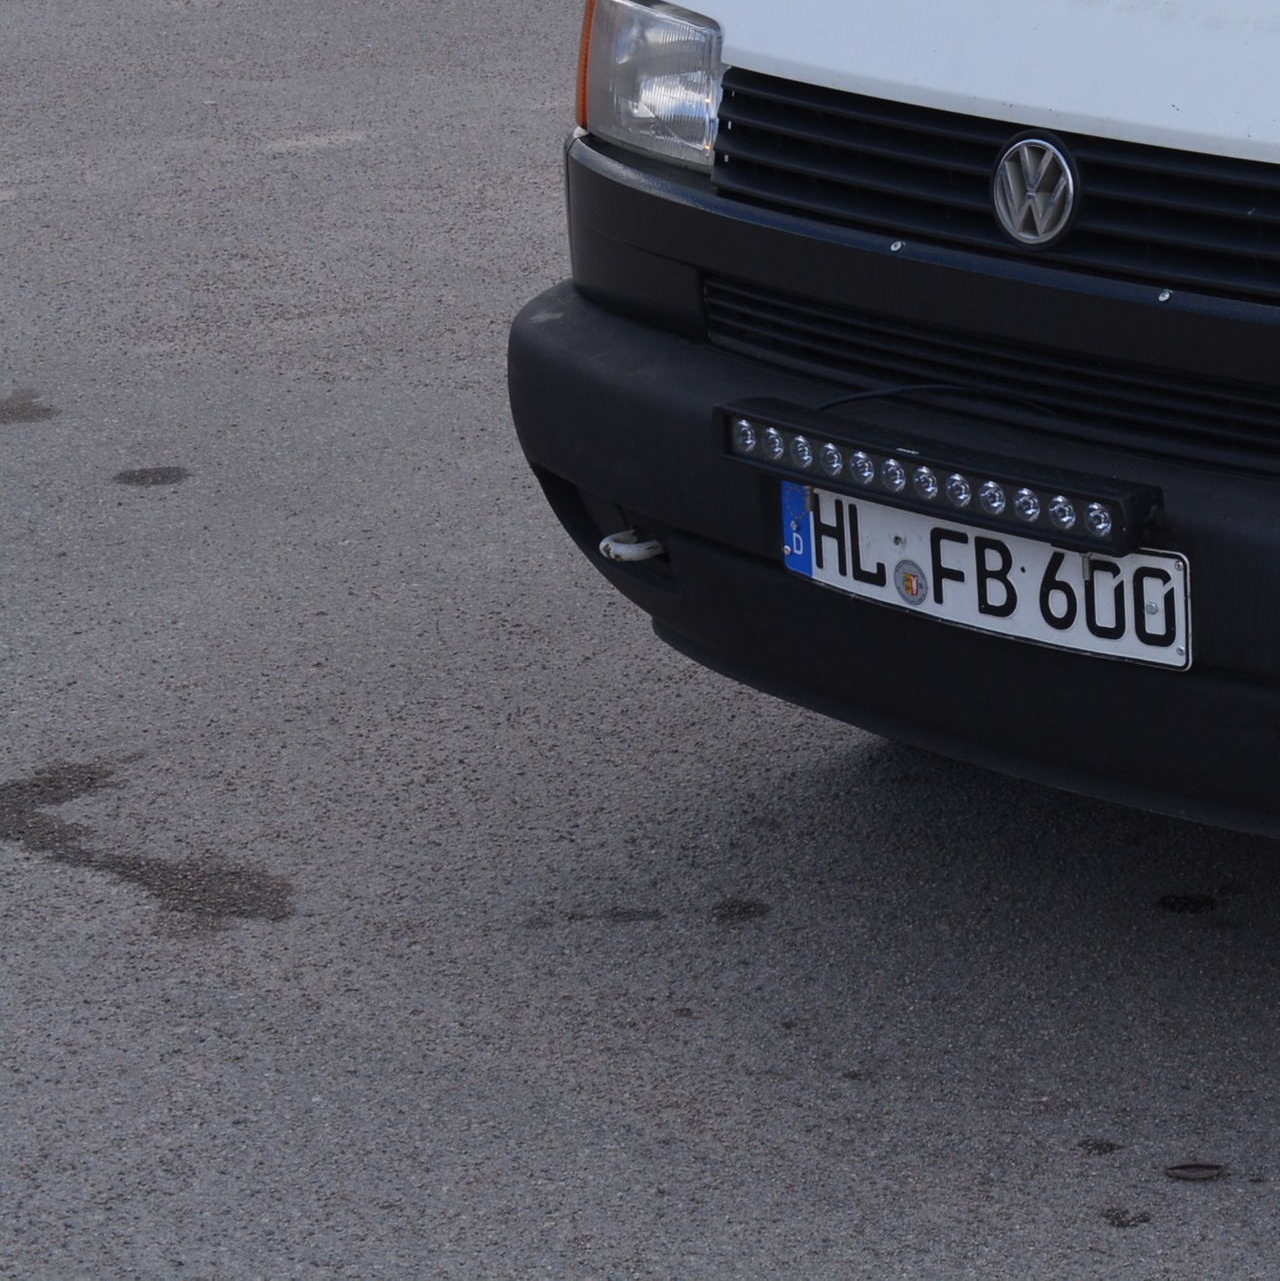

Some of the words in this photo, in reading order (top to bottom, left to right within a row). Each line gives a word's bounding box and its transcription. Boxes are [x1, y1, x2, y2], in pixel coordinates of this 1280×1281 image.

[793, 534, 805, 556] D
[814, 492, 887, 587] HL
[930, 527, 1018, 618] FB
[1039, 551, 1177, 648] 600
